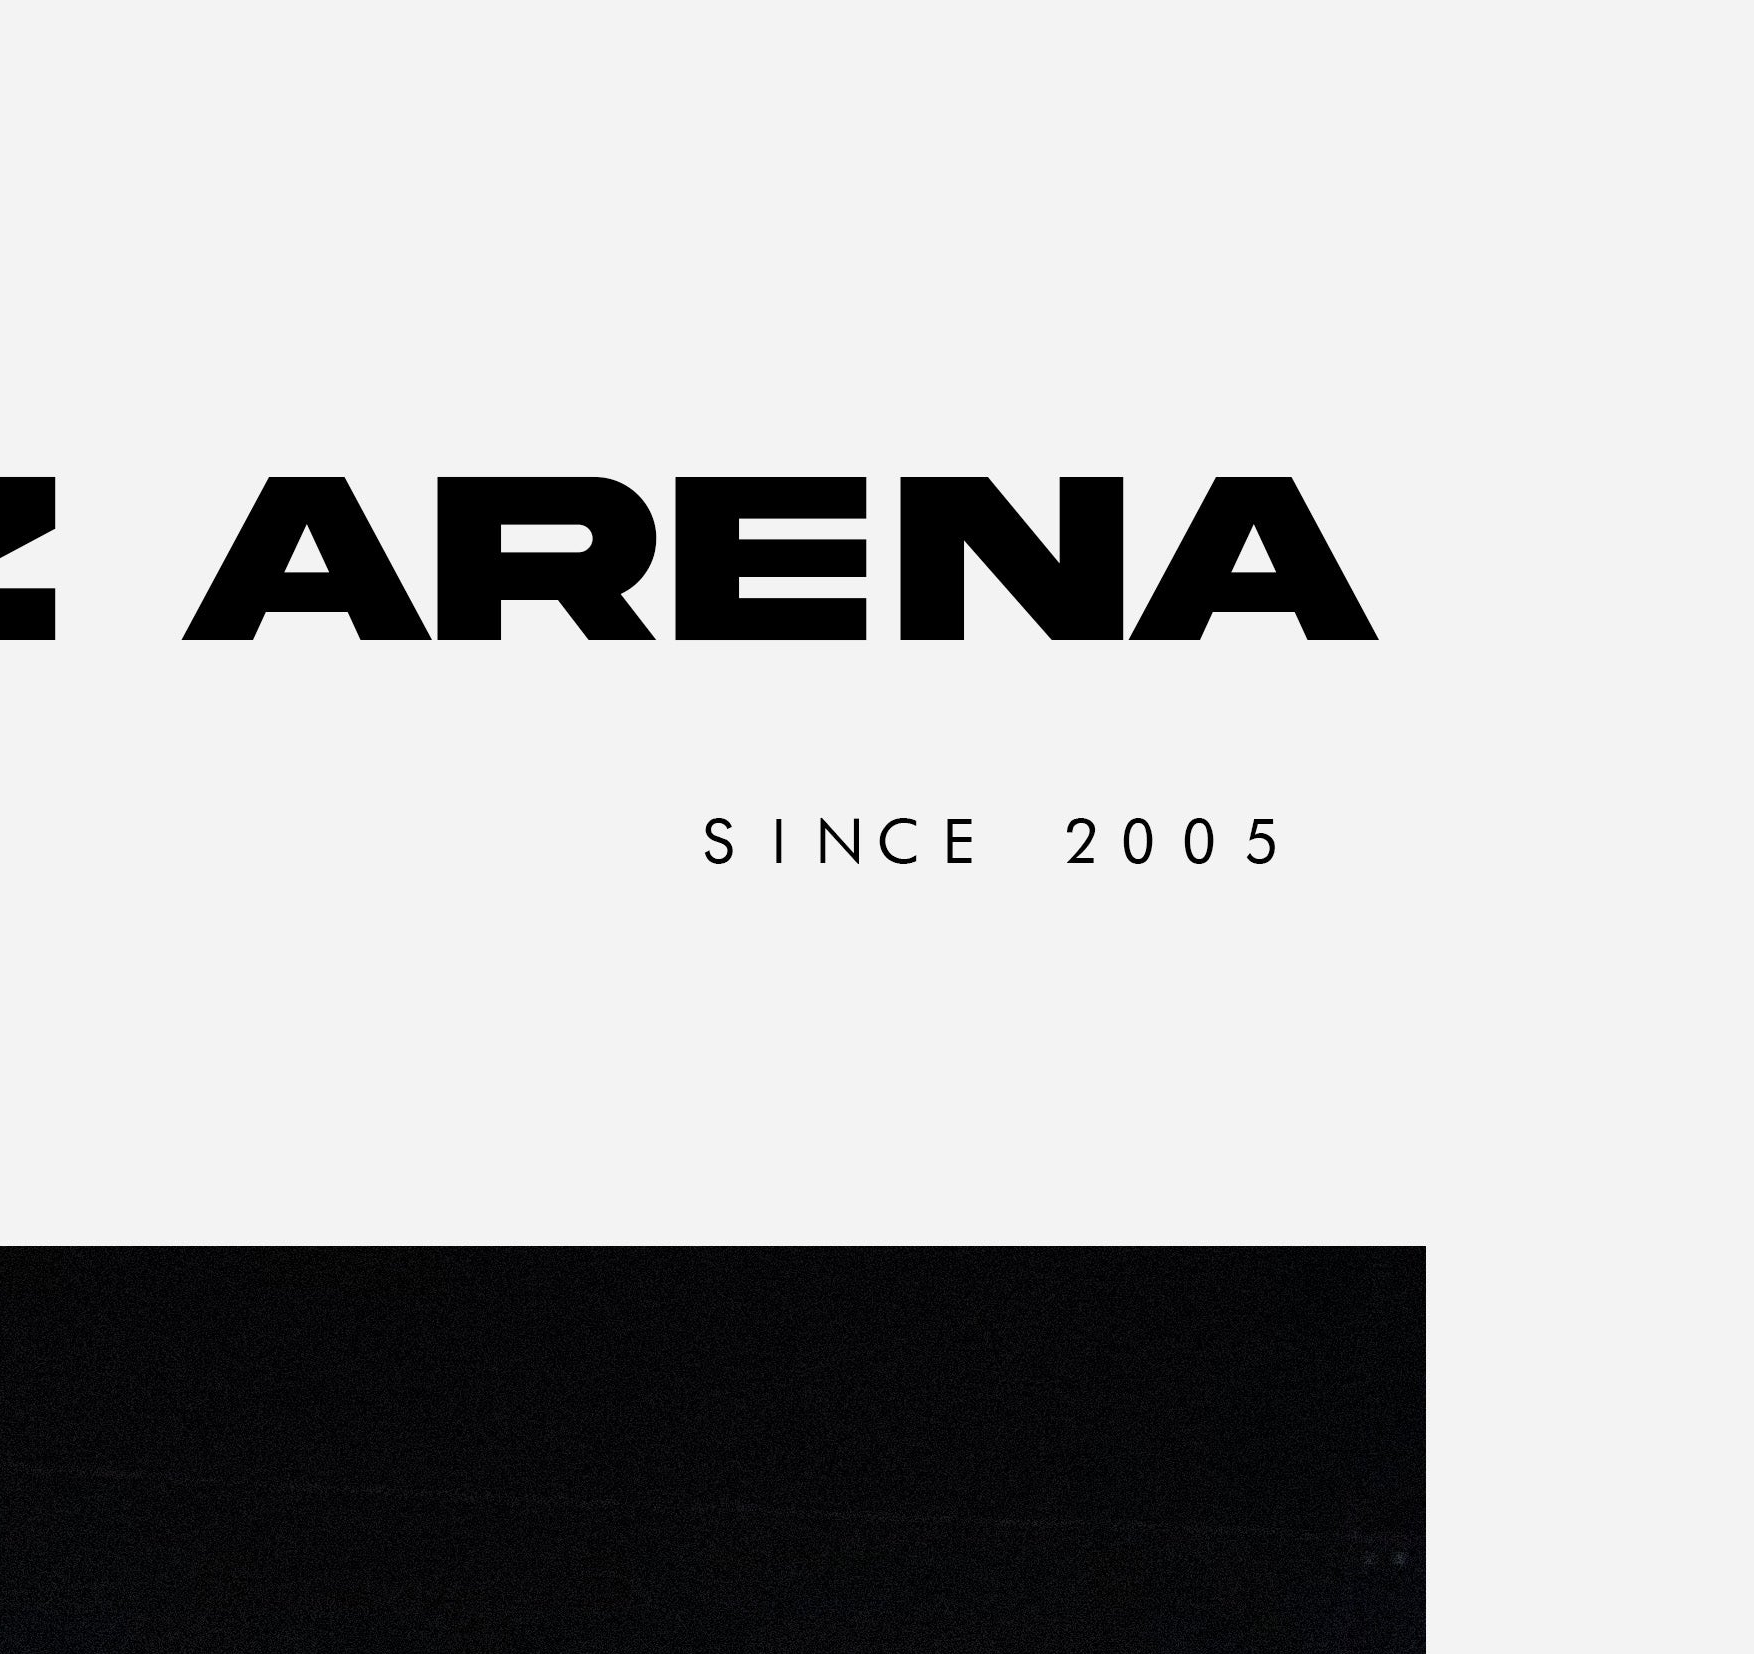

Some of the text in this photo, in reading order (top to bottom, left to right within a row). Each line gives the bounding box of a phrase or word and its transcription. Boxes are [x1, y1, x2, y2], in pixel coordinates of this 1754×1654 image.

[181, 476, 1380, 641] ARENA
[704, 817, 1276, 865] SINCE 2005
